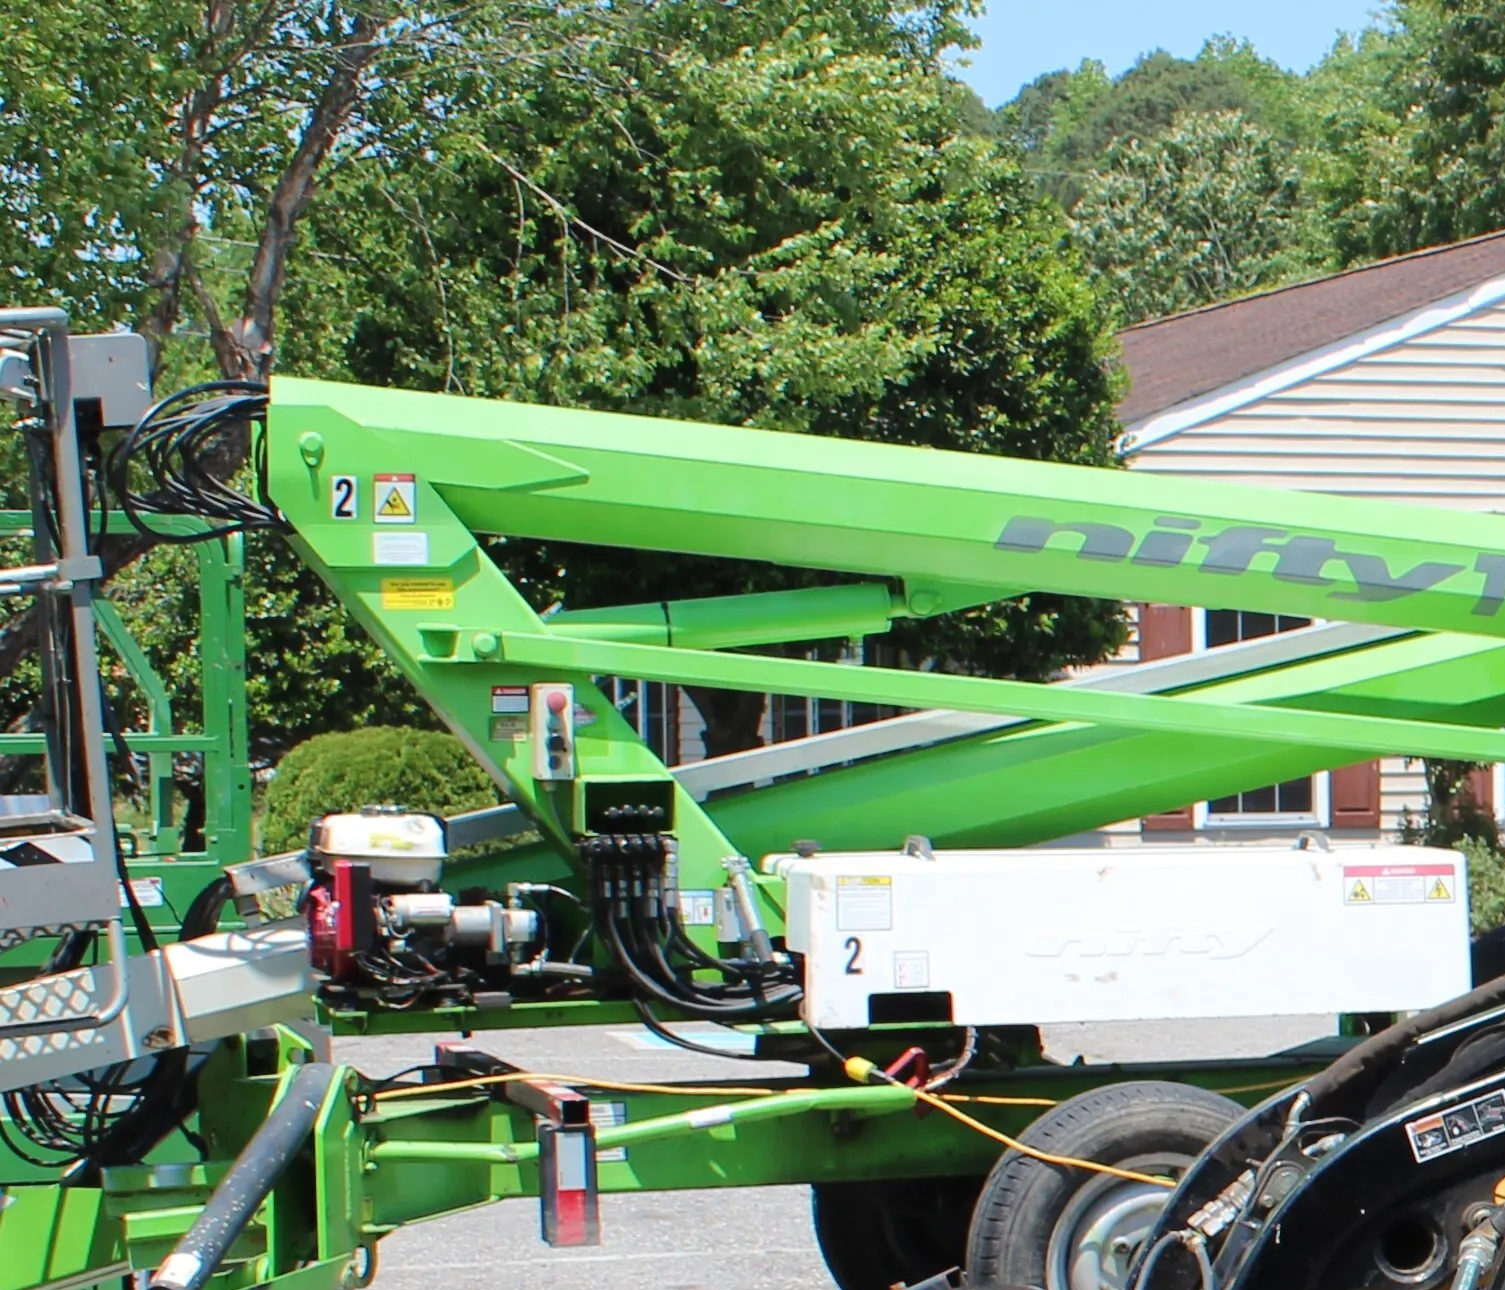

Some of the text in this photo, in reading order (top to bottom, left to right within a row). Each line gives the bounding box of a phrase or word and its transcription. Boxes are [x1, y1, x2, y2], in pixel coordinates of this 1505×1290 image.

[335, 478, 353, 517] 2
[992, 513, 1467, 602] nifty
[844, 936, 863, 975] 2
